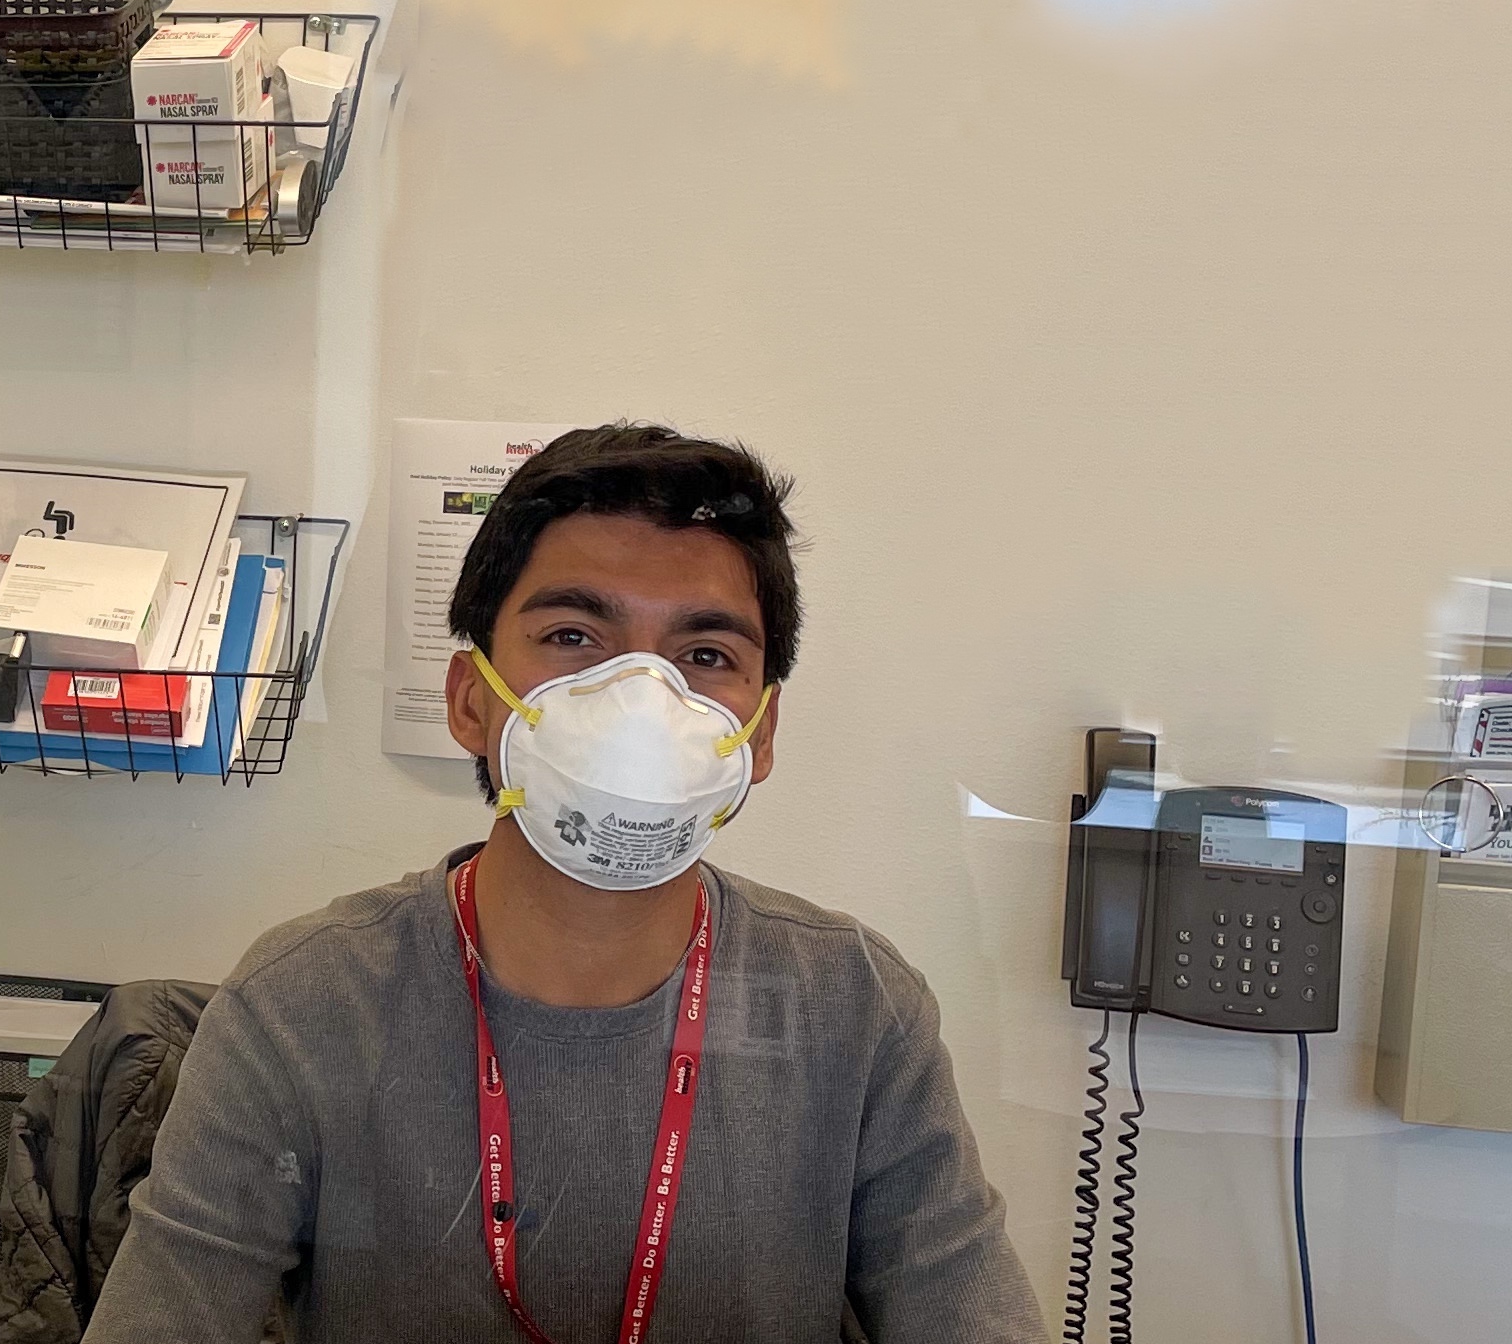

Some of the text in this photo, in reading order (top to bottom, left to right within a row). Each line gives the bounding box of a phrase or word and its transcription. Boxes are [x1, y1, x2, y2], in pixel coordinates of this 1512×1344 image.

[160, 105, 218, 118] NASAL SPRAY
[169, 173, 224, 185] NASAL SPRAY
[470, 465, 506, 476] Holiday
[1245, 797, 1280, 808] Polycom
[618, 817, 675, 831] WARNING
[587, 853, 610, 867] 3M
[489, 1134, 501, 1160] Get
[661, 1130, 680, 1174] Better.
[657, 1177, 670, 1195] Be
[647, 1201, 666, 1246] Better.
[643, 1249, 656, 1268] Do
[633, 1274, 652, 1317] Better.
